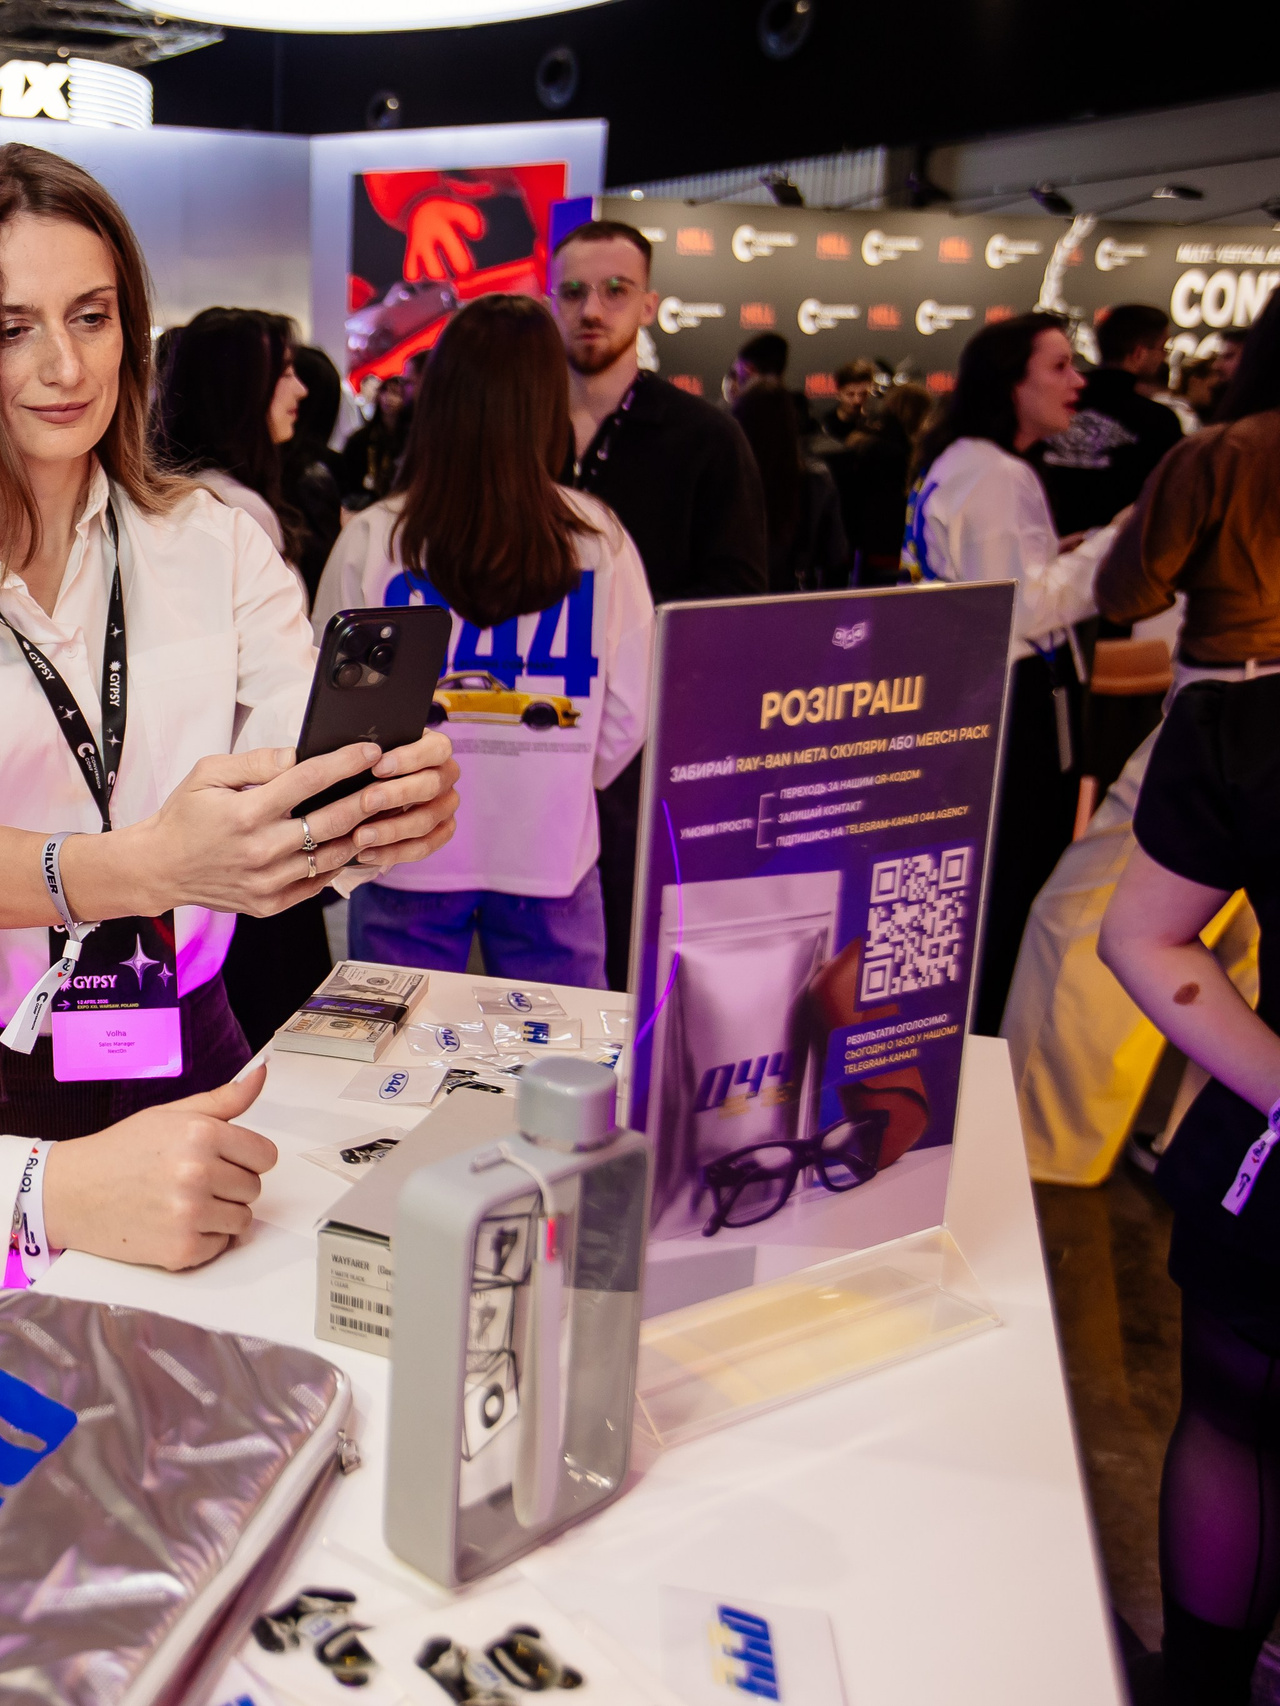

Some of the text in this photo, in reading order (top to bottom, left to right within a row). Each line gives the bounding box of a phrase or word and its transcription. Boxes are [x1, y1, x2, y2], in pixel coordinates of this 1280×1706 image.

[29, 652, 56, 681] GYPSY
[109, 674, 120, 707] GYPSY
[760, 675, 925, 730] РОЗІГРАШ
[84, 757, 94, 771] CONF
[670, 755, 736, 782] ЗАБИРАЙ
[736, 752, 792, 772] RAY-BAN
[830, 739, 888, 760] ОКУЛЯРИ
[888, 735, 914, 752] АБО
[916, 729, 957, 747] MERCH
[959, 724, 990, 741] PACK
[90, 755, 102, 789] CONVERSION
[780, 769, 922, 800] ПЕРЕХОДЬ ЗА НАШИМ QR-КОДОМ
[776, 829, 830, 848] ПІДПИШИСЬ
[830, 826, 844, 838] НА
[936, 806, 969, 819] AGENCY
[778, 801, 863, 824] ЗАЛИШАЙ КОНТАКТ
[680, 824, 715, 840] УМОВИ
[45, 842, 59, 895] SILVER
[73, 974, 118, 990] GYPSY
[845, 1043, 886, 1060] СЬОГОДНІ
[922, 1024, 959, 1041] НАШОМУ
[846, 1013, 948, 1046] РЕЗУЛЬТАТИ ОГОЛОСИМО
[844, 1048, 918, 1075] TELEGRAM-КАНАЛІ
[384, 1072, 406, 1094] 044
[331, 1253, 370, 1271] WAYFARER
